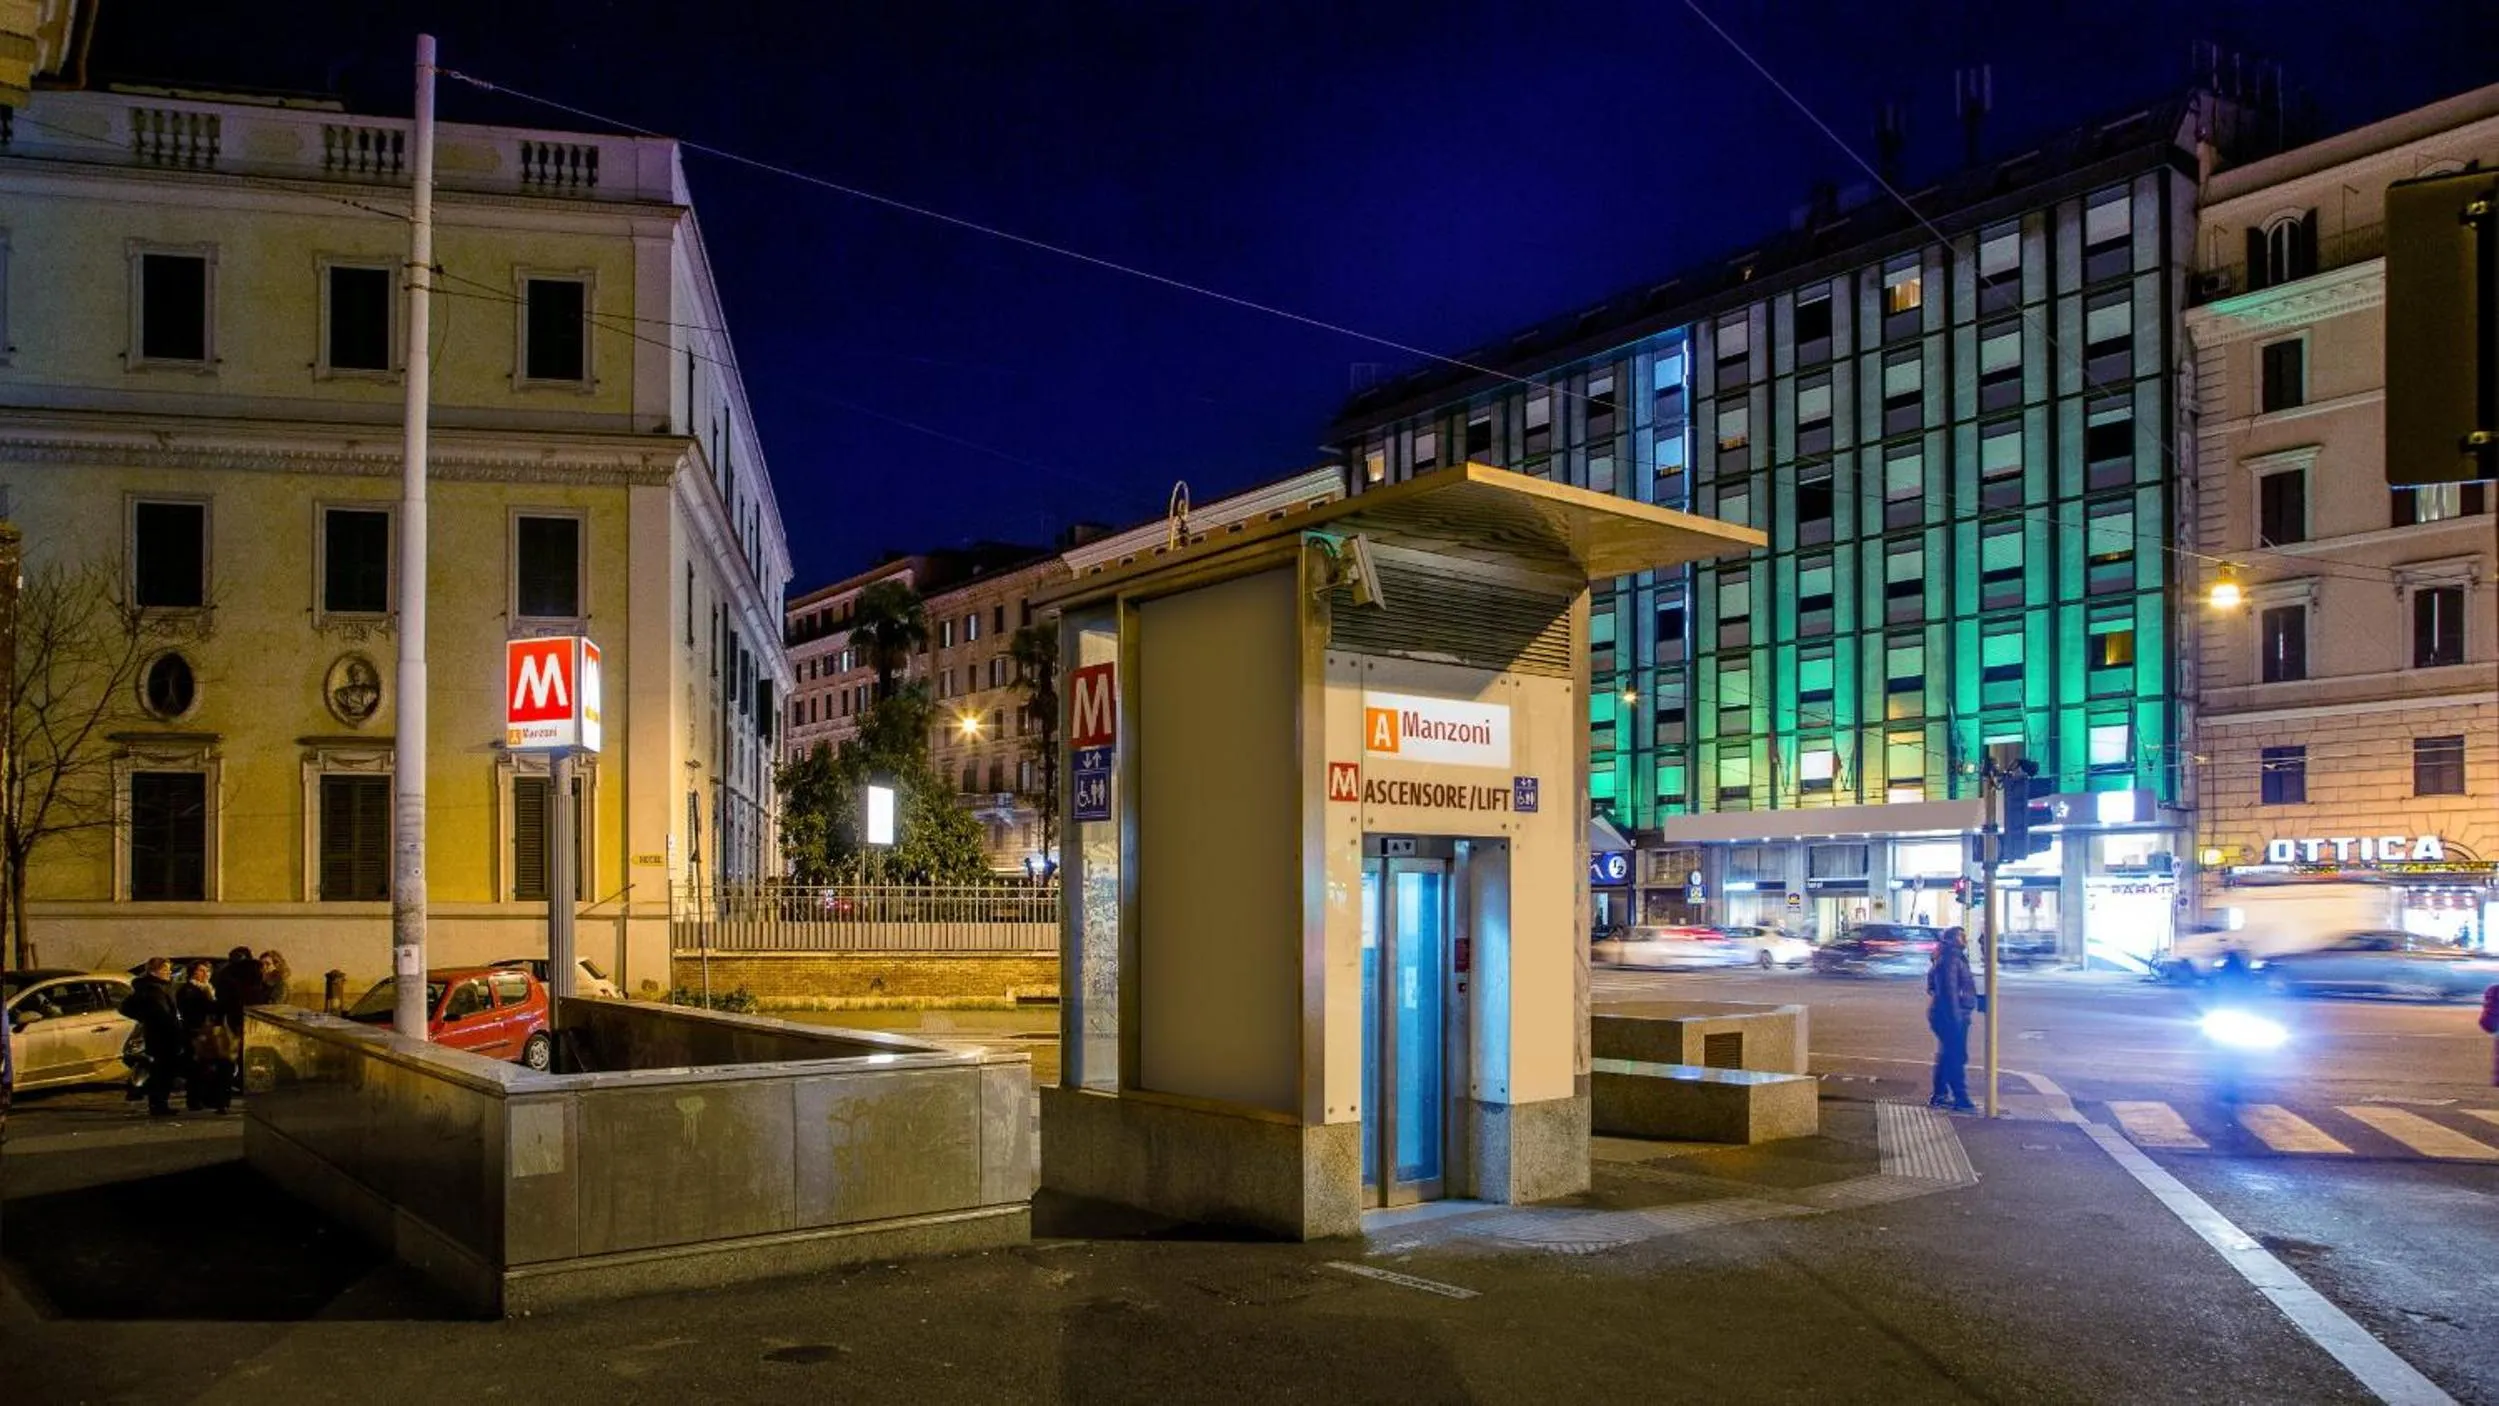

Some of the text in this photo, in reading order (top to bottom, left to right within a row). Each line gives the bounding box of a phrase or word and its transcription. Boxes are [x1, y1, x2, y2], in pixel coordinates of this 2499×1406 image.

[512, 652, 569, 710] M
[1072, 673, 1113, 739] M
[1373, 711, 1491, 748] A Manzoni
[1331, 767, 1511, 812] M ASCENSORE/LIFT
[2269, 836, 2444, 863] OTTICA
